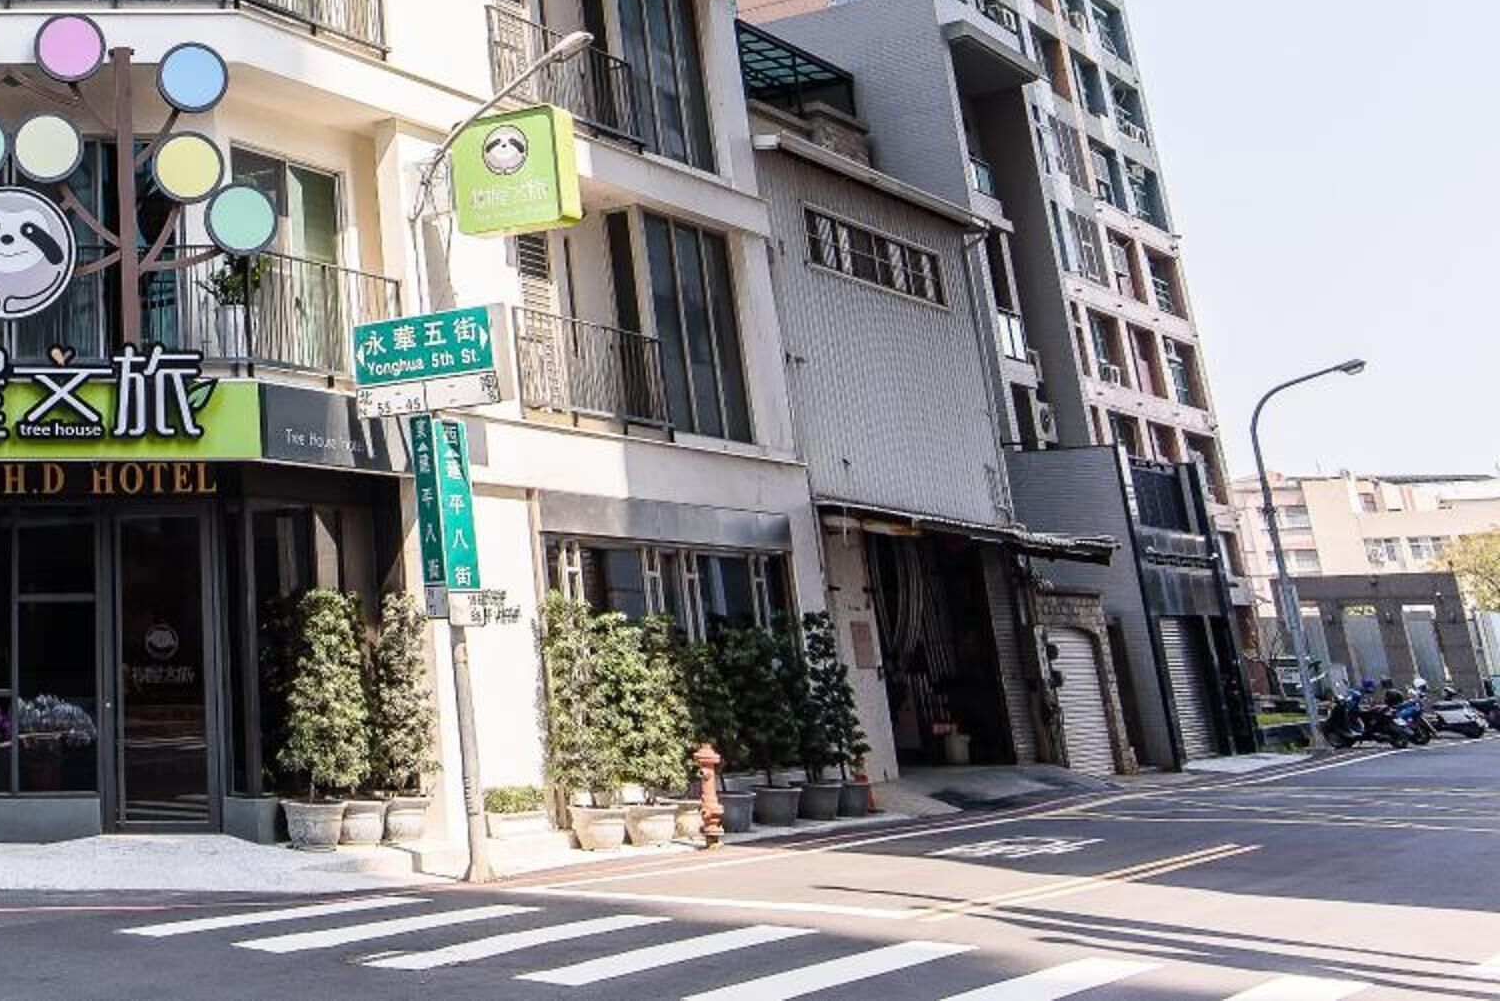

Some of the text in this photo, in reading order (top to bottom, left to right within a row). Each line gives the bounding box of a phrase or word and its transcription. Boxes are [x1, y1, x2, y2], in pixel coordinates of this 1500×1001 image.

[364, 316, 478, 356] 永華五街
[366, 347, 481, 377] Yonghua 5th St.
[19, 422, 103, 437] tree house
[91, 462, 218, 496] HOTEL
[444, 459, 473, 587] 建平八街
